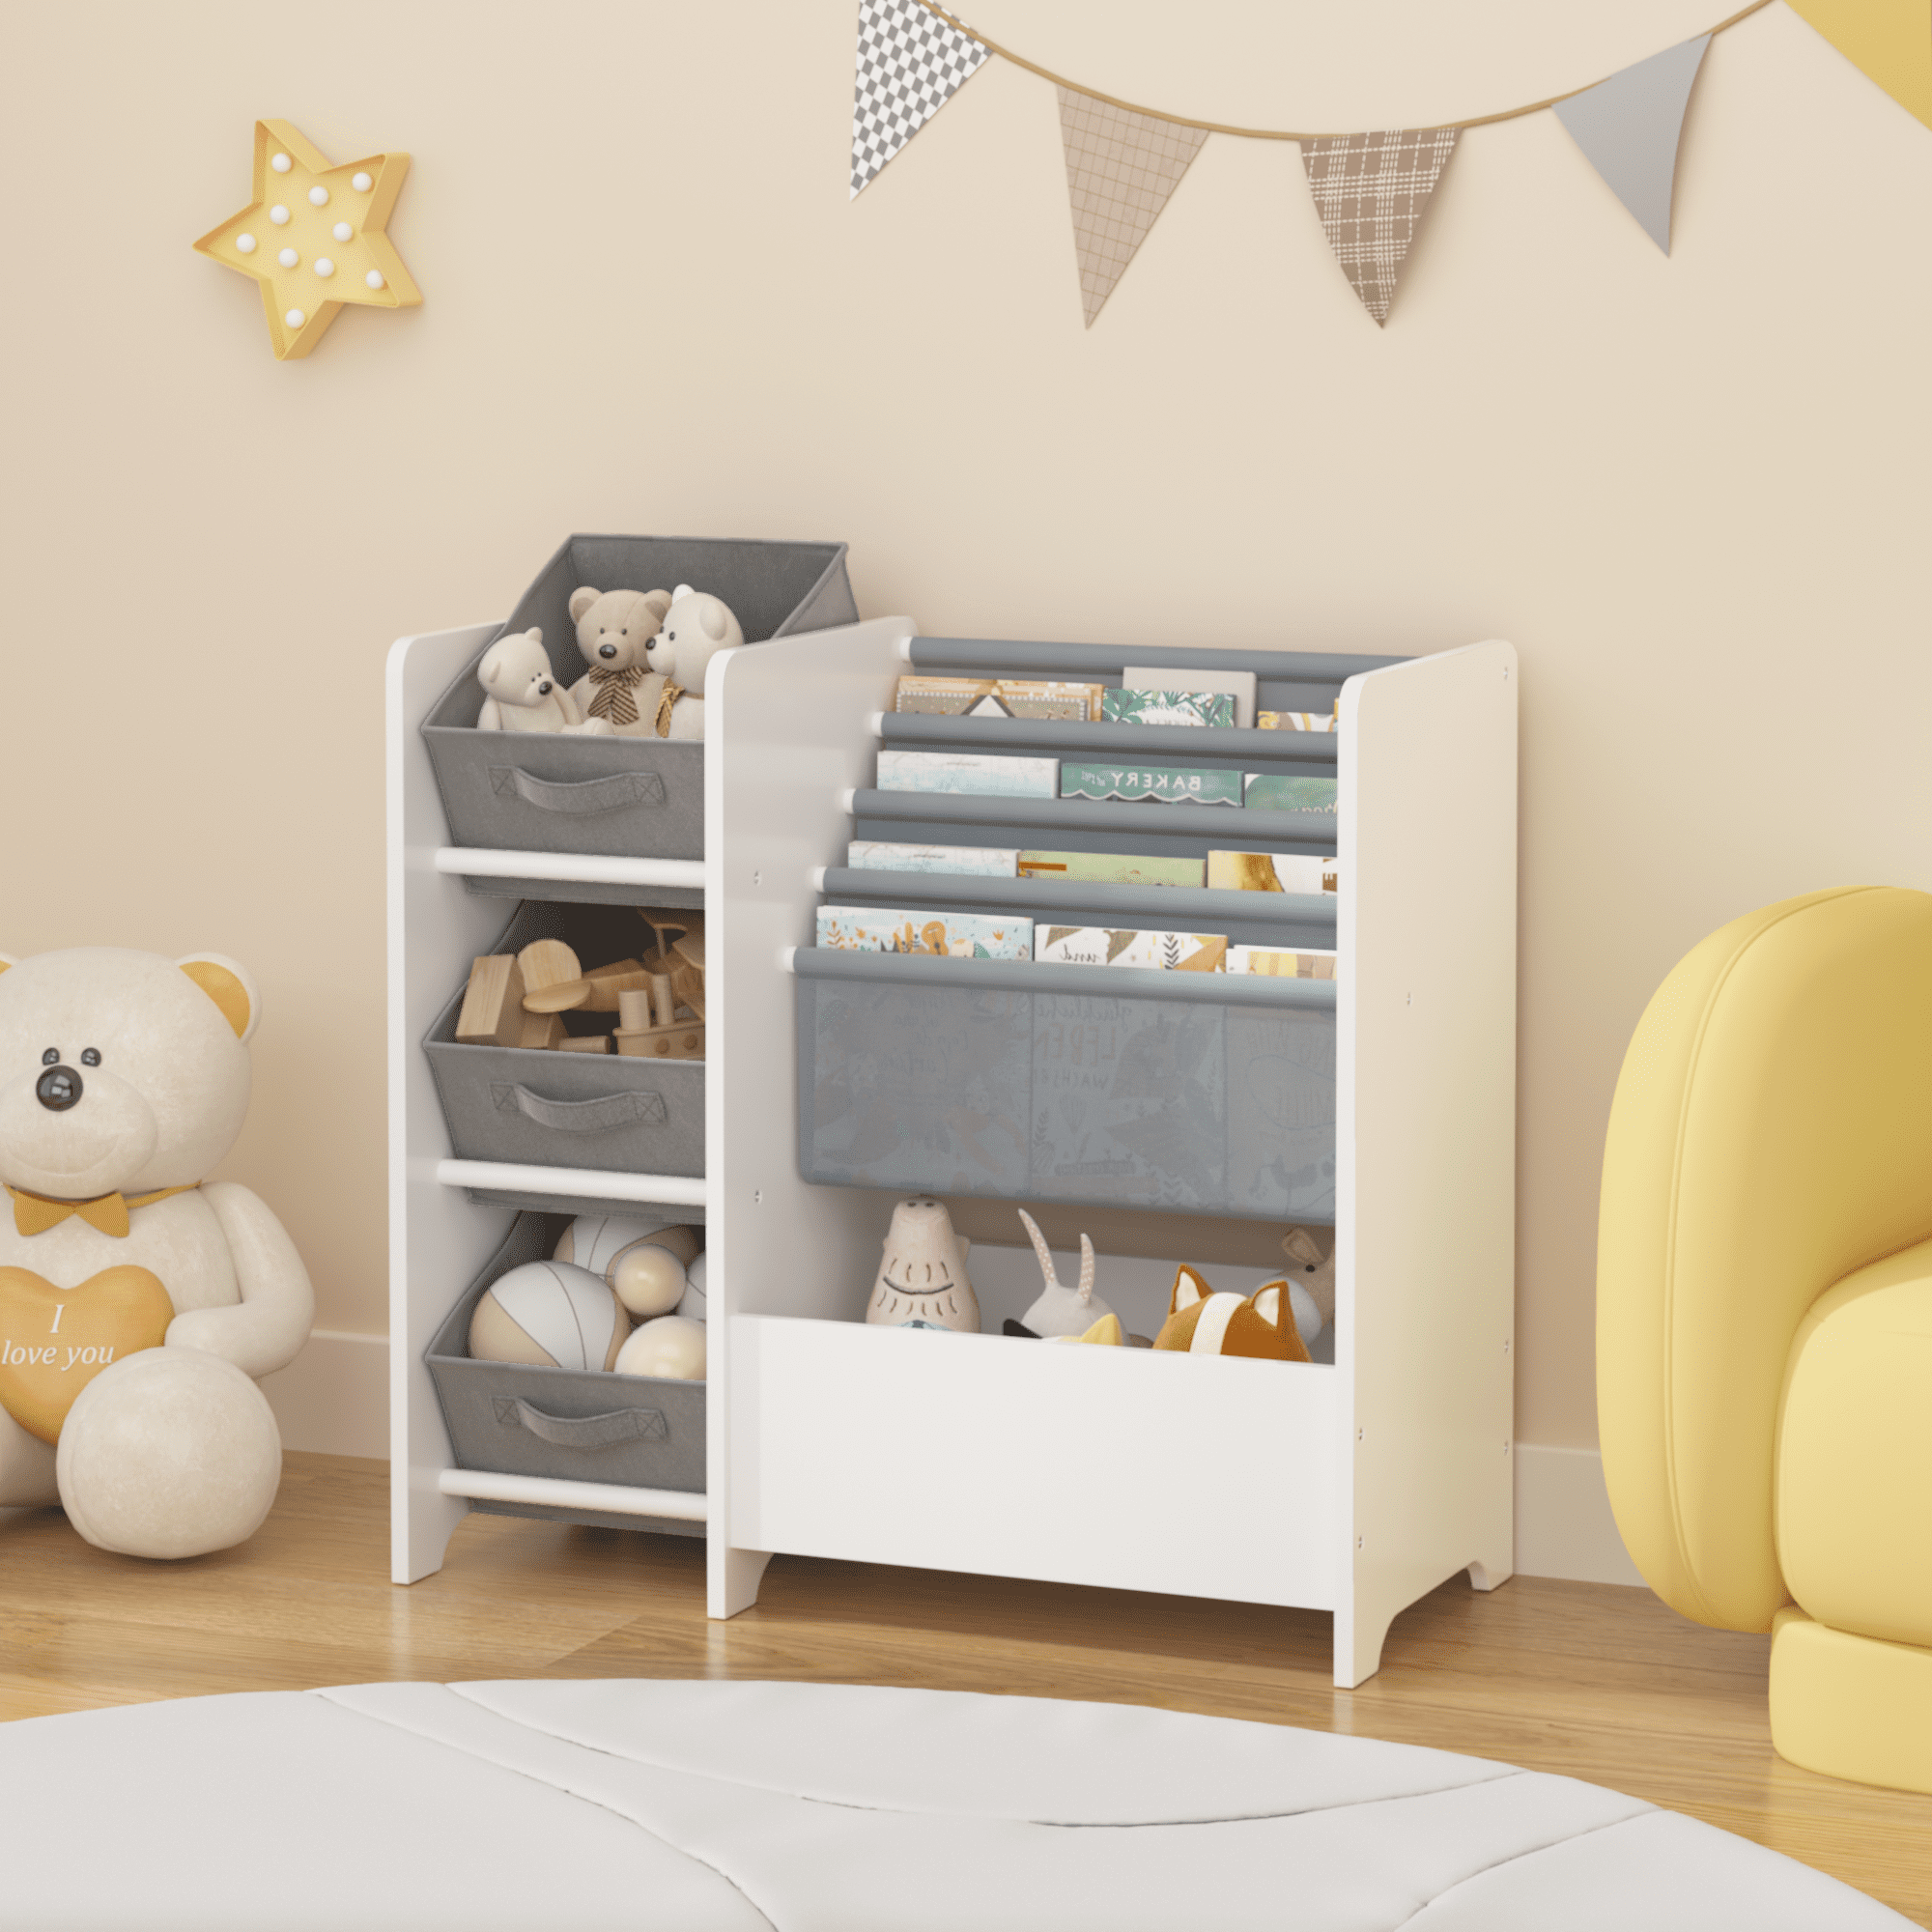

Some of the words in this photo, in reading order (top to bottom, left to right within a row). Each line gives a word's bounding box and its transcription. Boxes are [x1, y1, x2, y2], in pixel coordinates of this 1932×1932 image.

[49, 1304, 65, 1334] I
[1, 1339, 58, 1365] love
[60, 1346, 114, 1372] you
